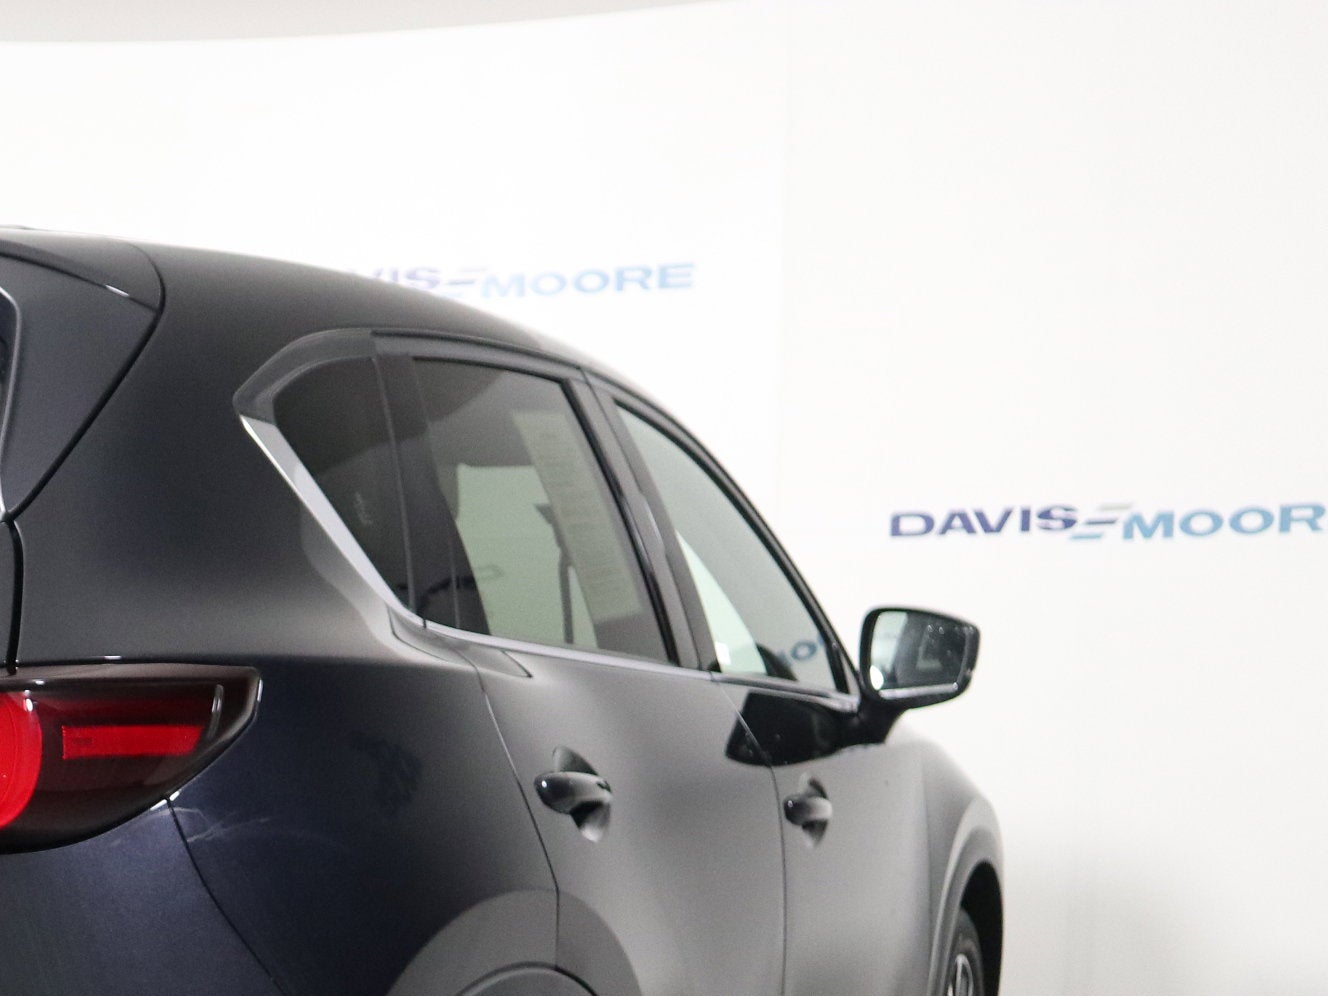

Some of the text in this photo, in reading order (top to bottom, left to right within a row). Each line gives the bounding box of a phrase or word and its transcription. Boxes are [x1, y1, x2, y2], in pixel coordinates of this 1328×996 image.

[481, 261, 695, 299] MOORE
[889, 502, 1327, 541] DAVIS MOOR
